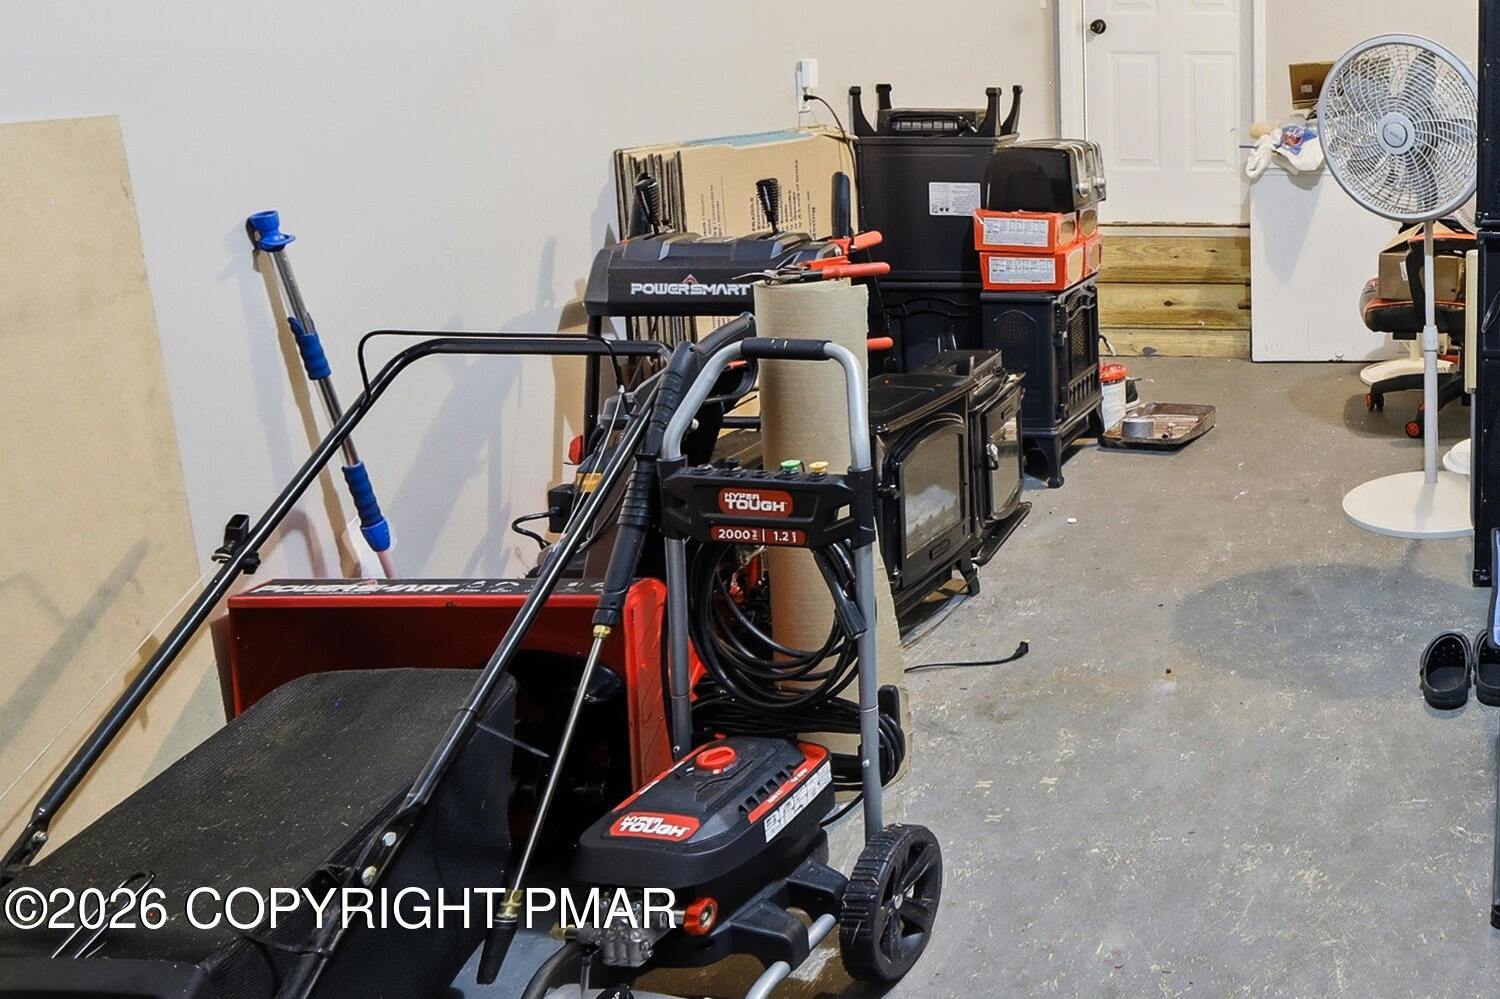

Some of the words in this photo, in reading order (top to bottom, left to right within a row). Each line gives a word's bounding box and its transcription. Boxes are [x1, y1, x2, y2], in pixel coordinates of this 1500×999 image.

[630, 282, 751, 296] POWERSMART
[724, 492, 760, 502] HYPER
[725, 500, 785, 512] TOUGH
[718, 528, 750, 540] 2000
[774, 531, 789, 542] 1.2
[620, 815, 664, 826] HYPER
[620, 822, 687, 837] TOUGH
